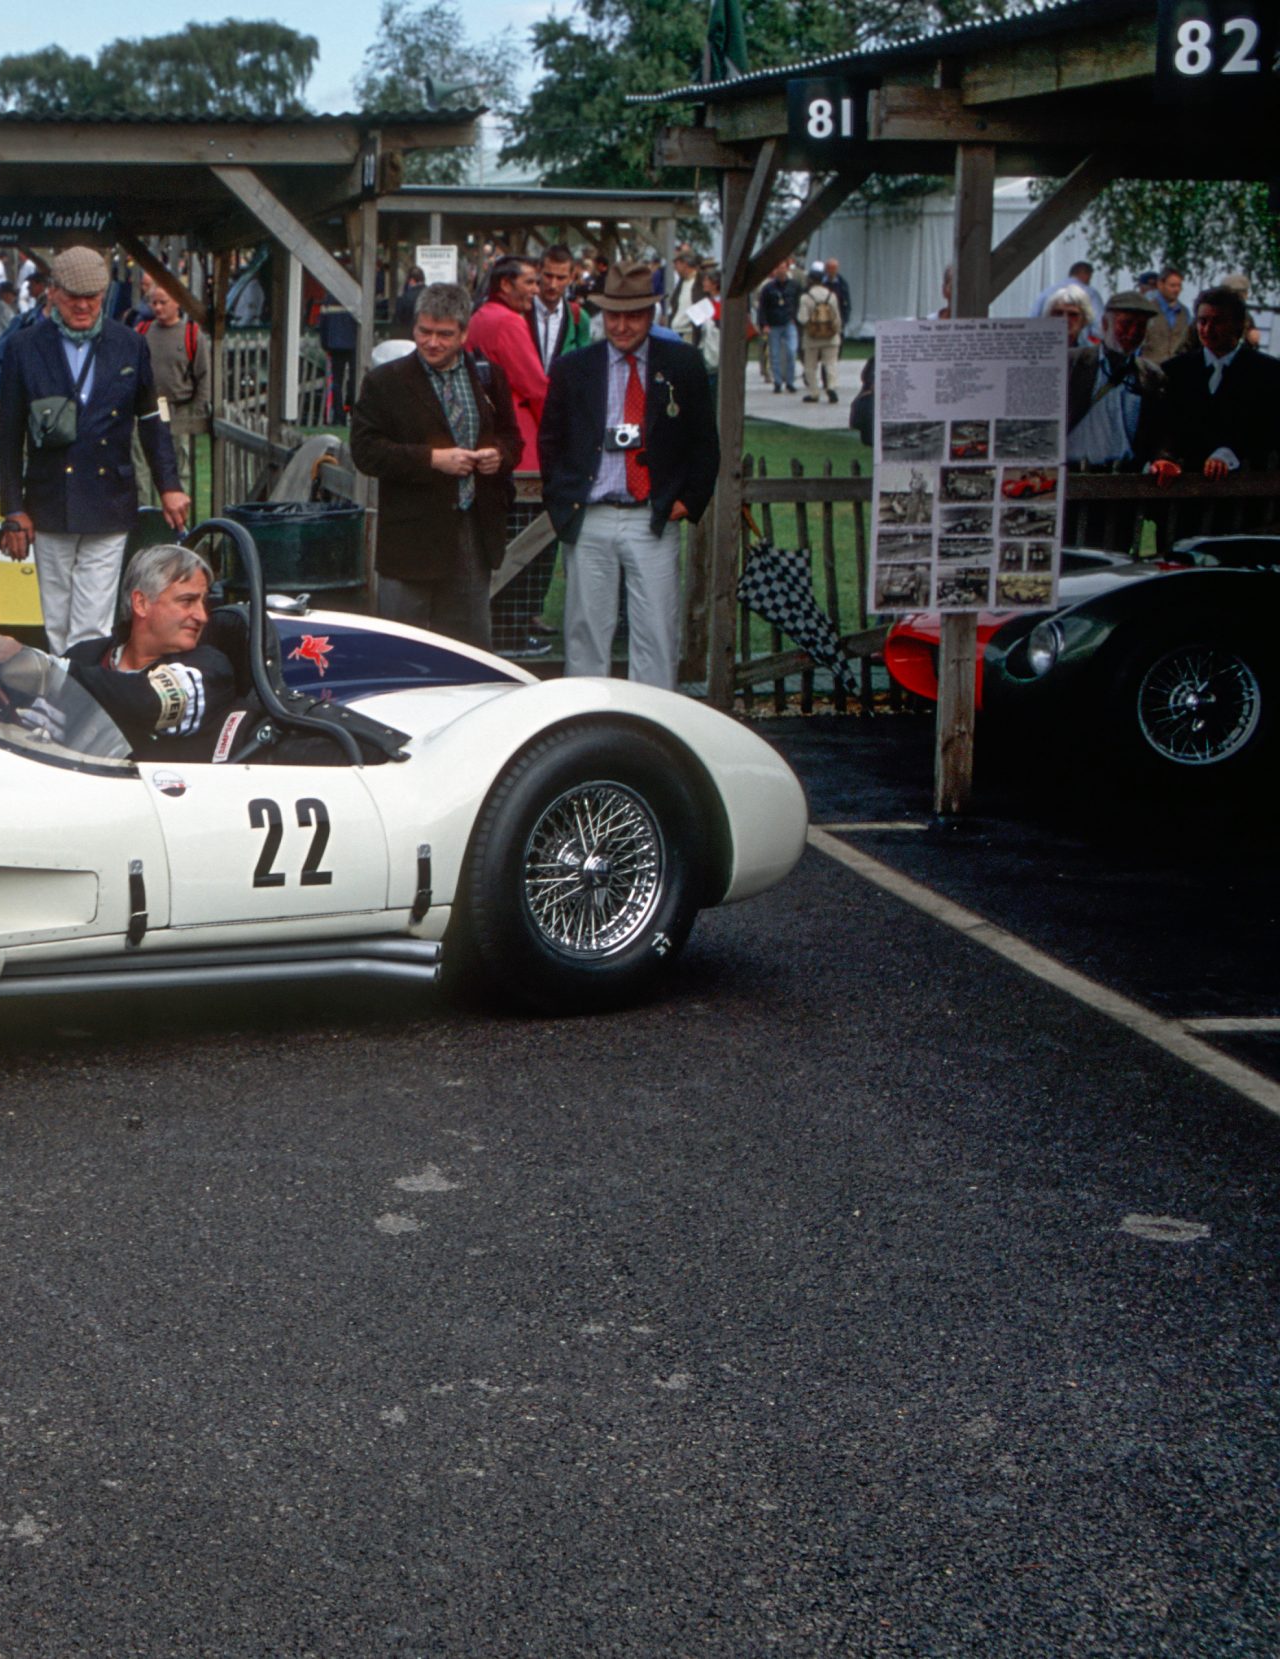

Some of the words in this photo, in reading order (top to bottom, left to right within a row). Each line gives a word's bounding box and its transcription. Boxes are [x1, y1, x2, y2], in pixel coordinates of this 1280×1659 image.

[1174, 17, 1258, 75] 82
[806, 98, 852, 139] 81
[155, 672, 181, 721] DRIVER
[247, 797, 334, 888] 22
